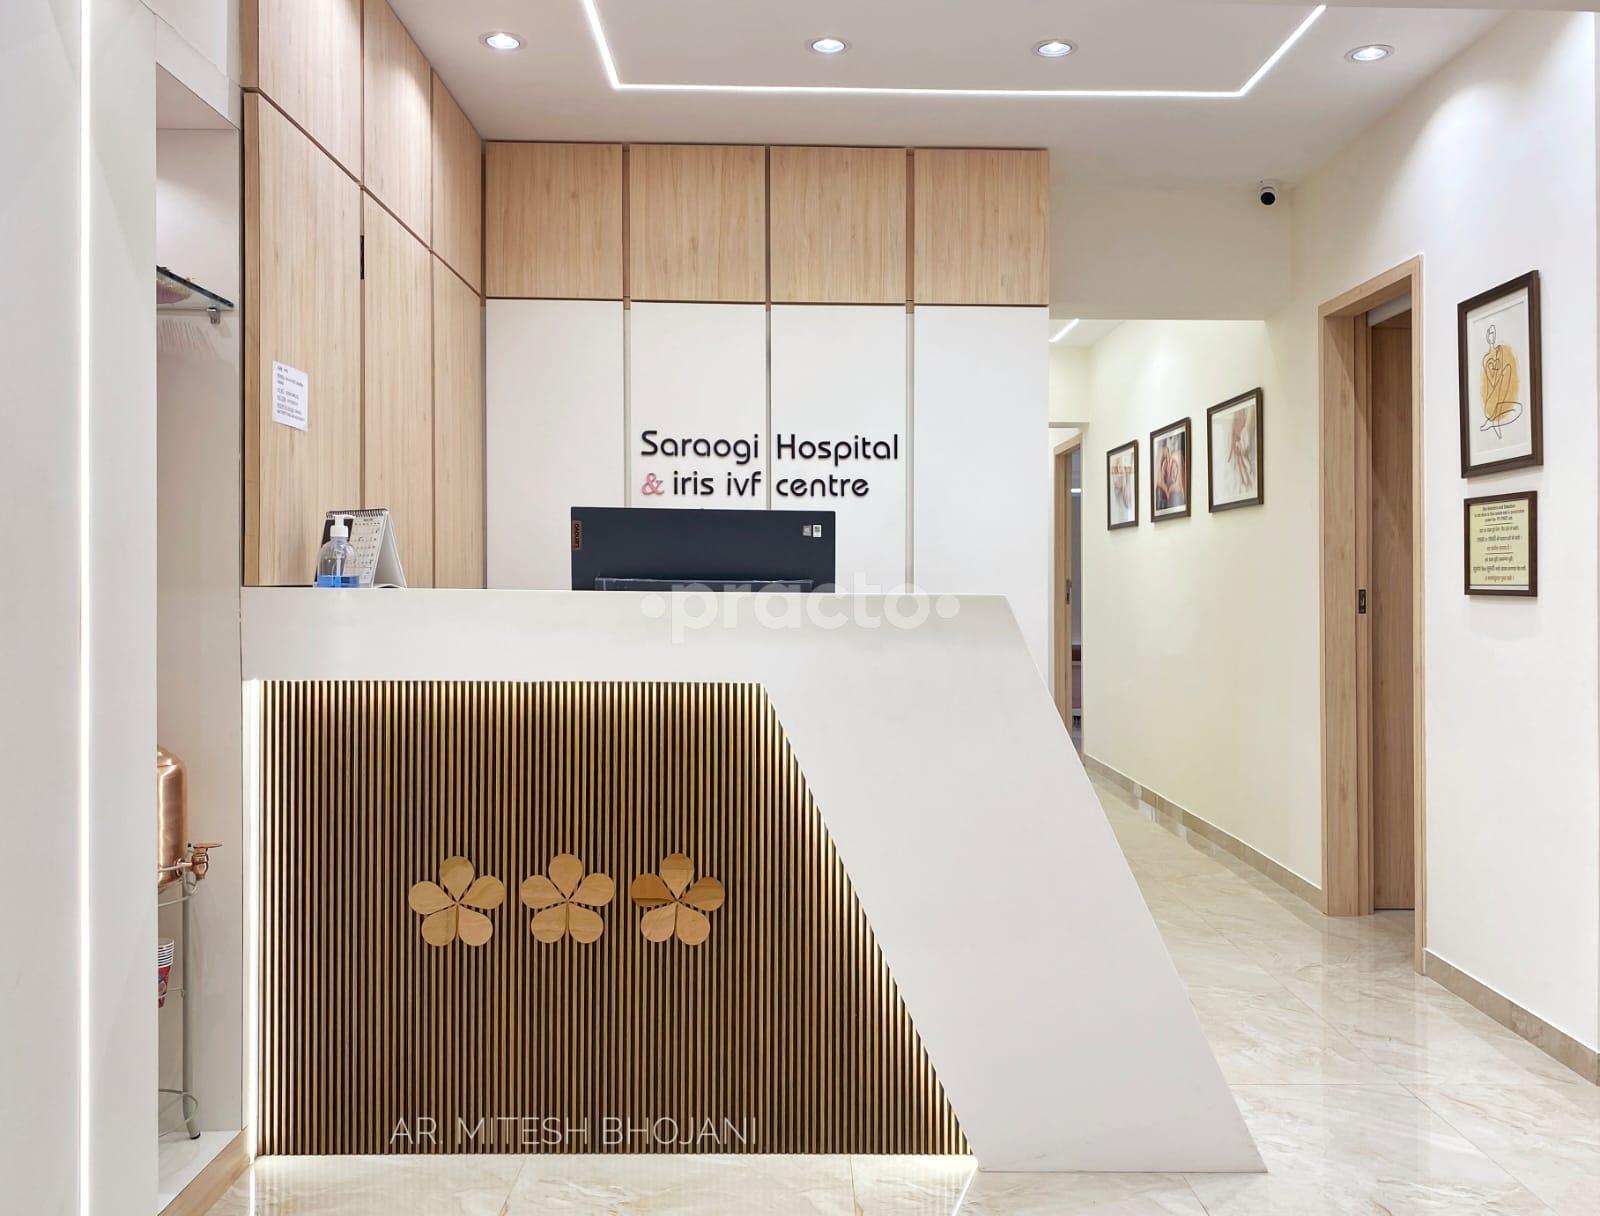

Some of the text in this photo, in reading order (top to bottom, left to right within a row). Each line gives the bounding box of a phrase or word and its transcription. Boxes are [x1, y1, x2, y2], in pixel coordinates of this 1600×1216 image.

[640, 430, 899, 467] Saraogi Hospital
[640, 470, 869, 498] & iris ivf centre
